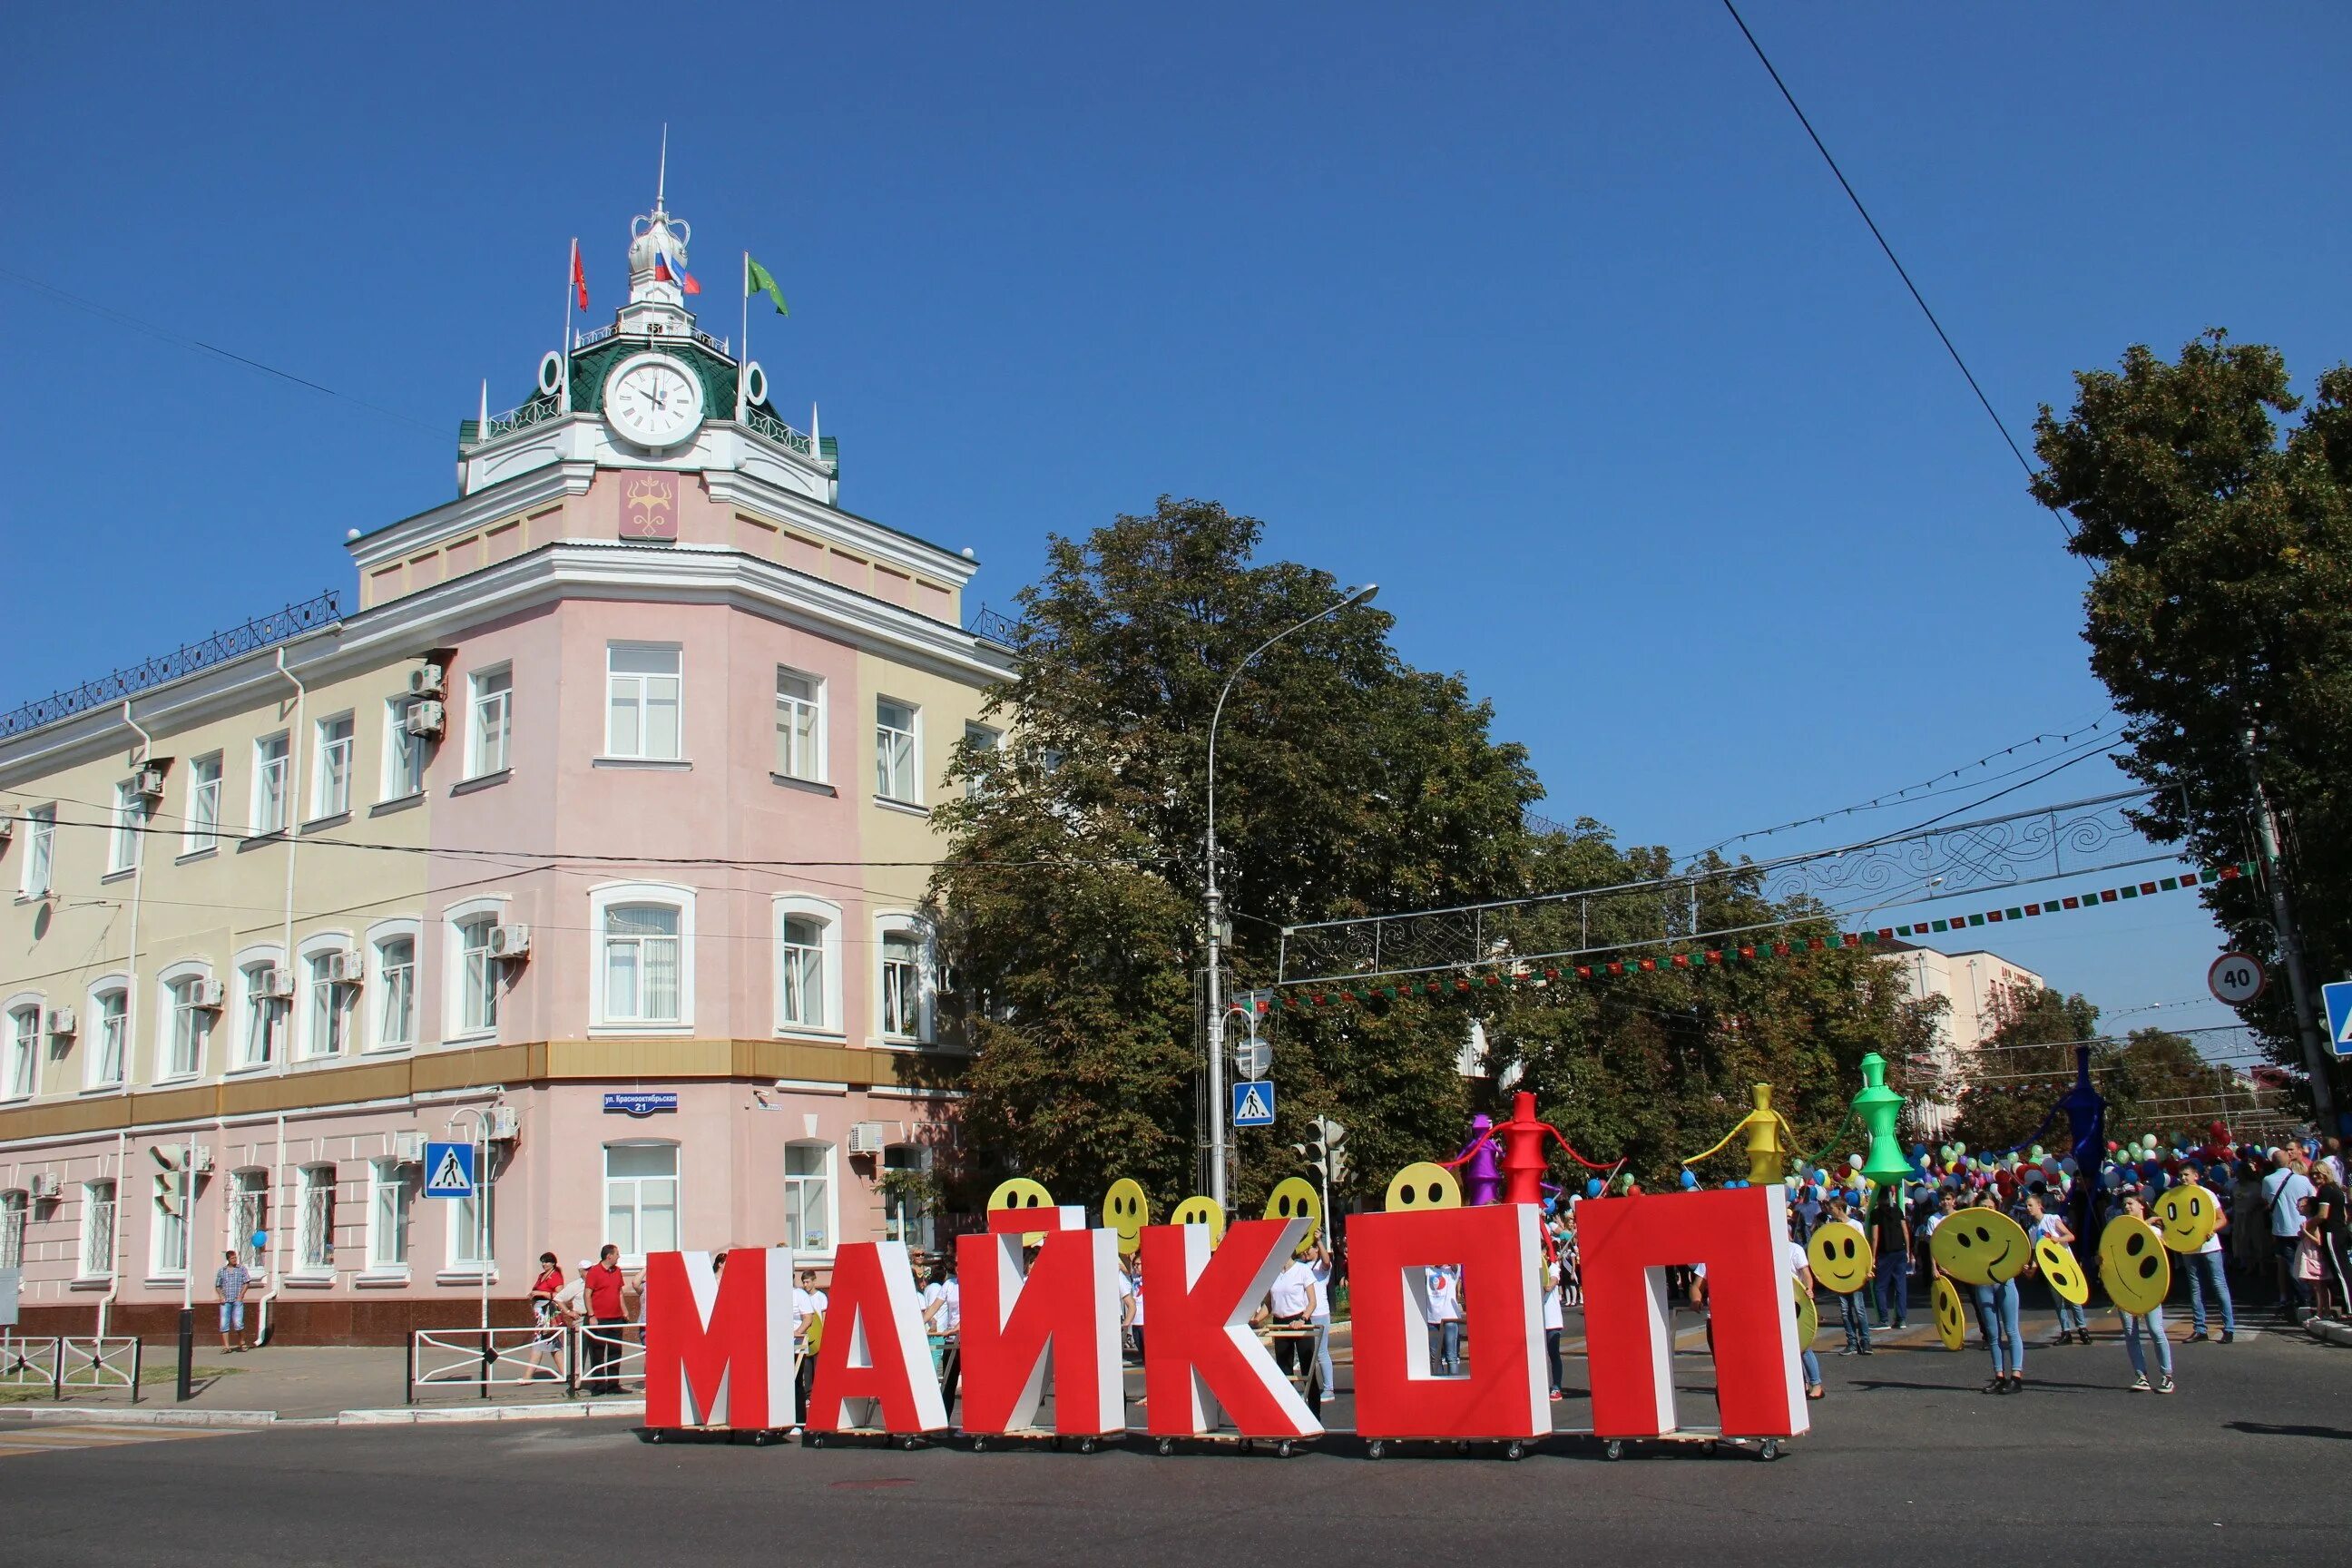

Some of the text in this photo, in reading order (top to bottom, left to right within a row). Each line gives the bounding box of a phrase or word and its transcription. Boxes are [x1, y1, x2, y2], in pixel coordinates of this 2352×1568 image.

[2224, 968, 2250, 989] 40
[605, 1094, 677, 1104] ул. Краснооктябрьская
[634, 1102, 646, 1112] 21
[645, 1185, 1811, 1440] МАЙКОП
